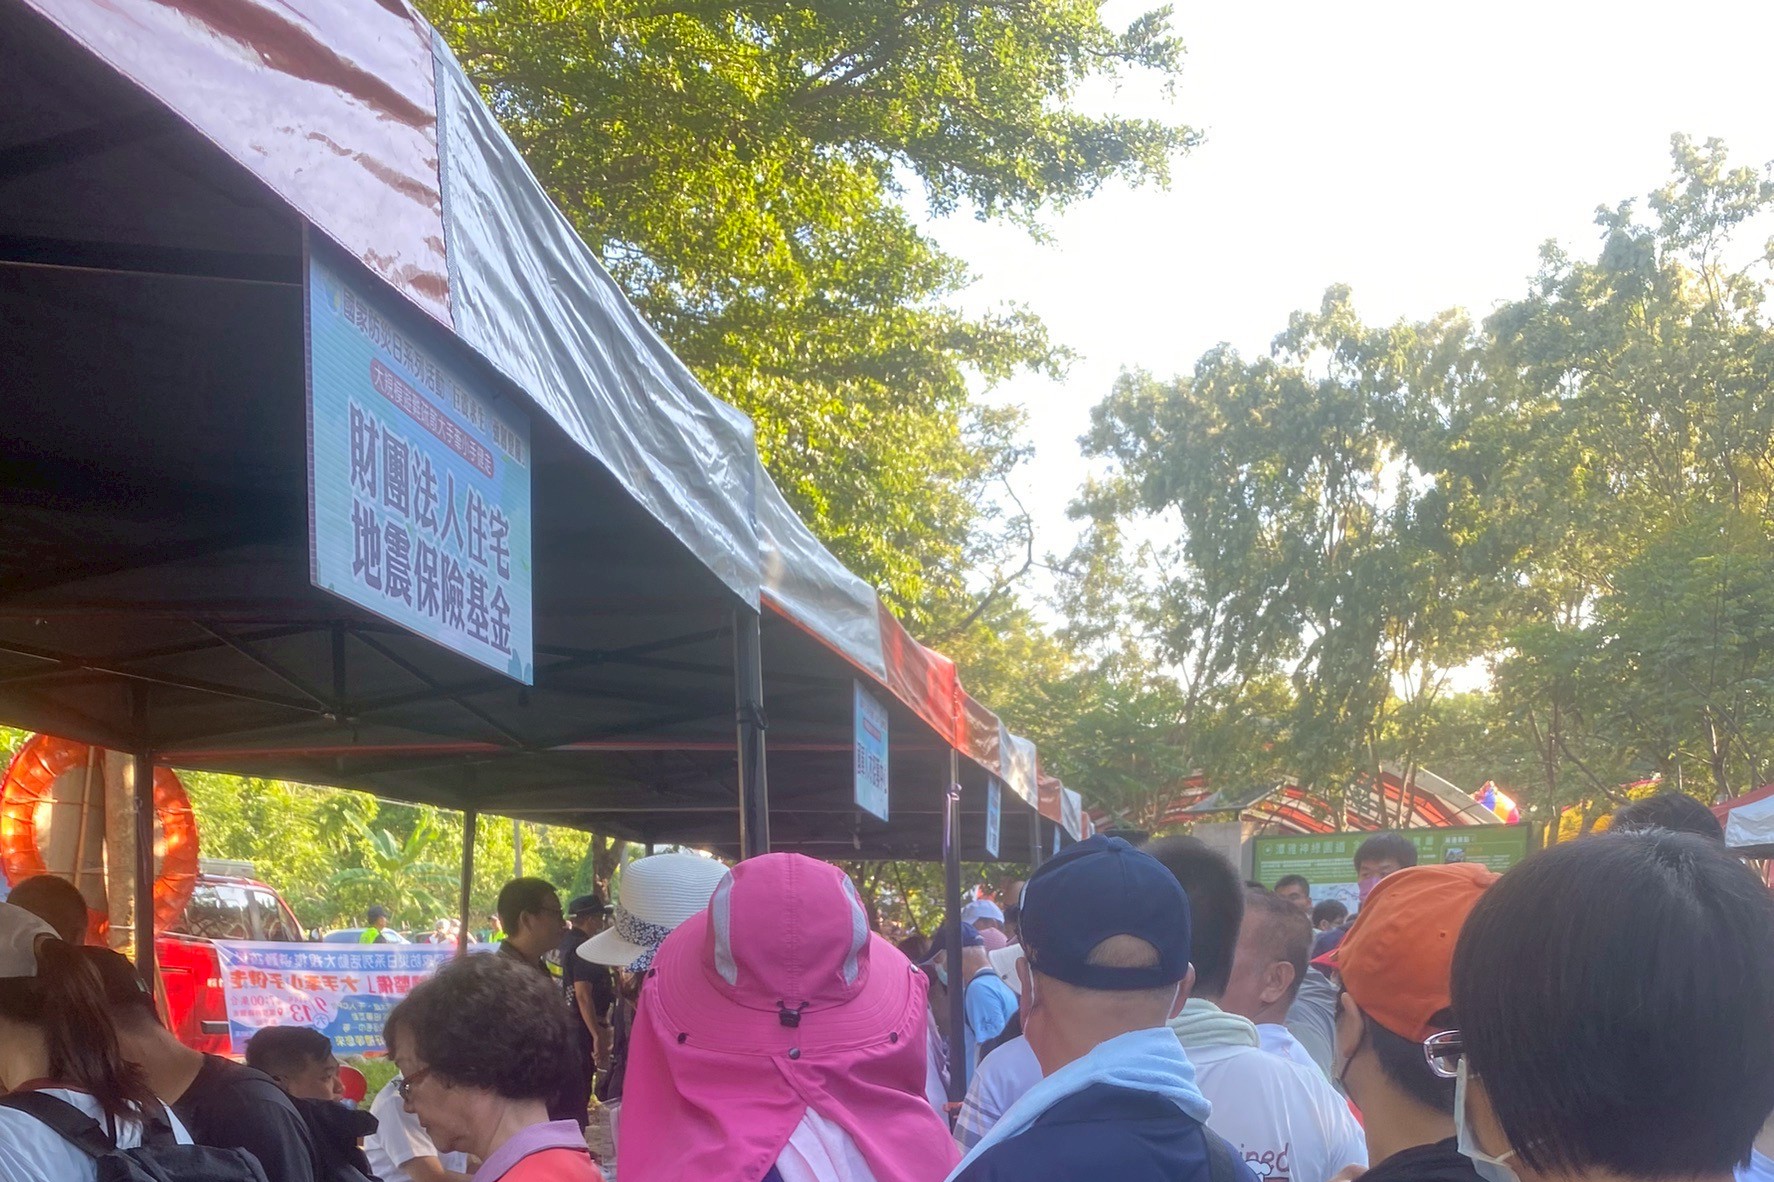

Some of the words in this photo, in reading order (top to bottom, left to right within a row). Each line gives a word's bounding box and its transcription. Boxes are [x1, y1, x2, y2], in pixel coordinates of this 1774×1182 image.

[349, 402, 511, 581] 財團法人住宅
[350, 501, 512, 656] 地震保險基金
